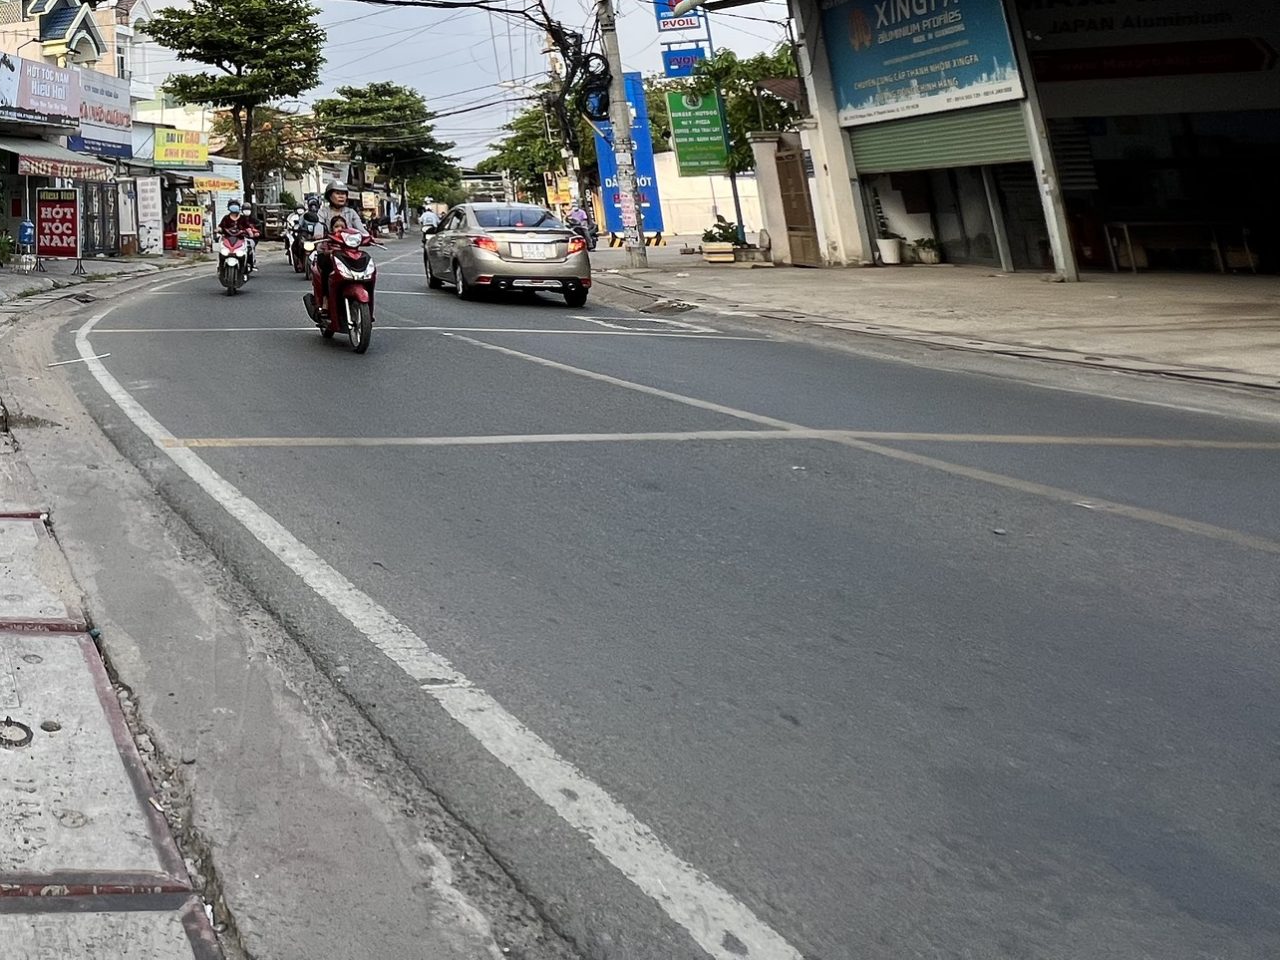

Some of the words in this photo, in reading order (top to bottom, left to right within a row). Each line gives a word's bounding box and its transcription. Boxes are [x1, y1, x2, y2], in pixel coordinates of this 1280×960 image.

[662, 18, 696, 28] PVOIL
[952, 54, 979, 70] XINGFA
[55, 71, 69, 83] NAM
[80, 166, 107, 181] NAM
[42, 219, 72, 234] TÓC
[40, 235, 76, 248] NAM
